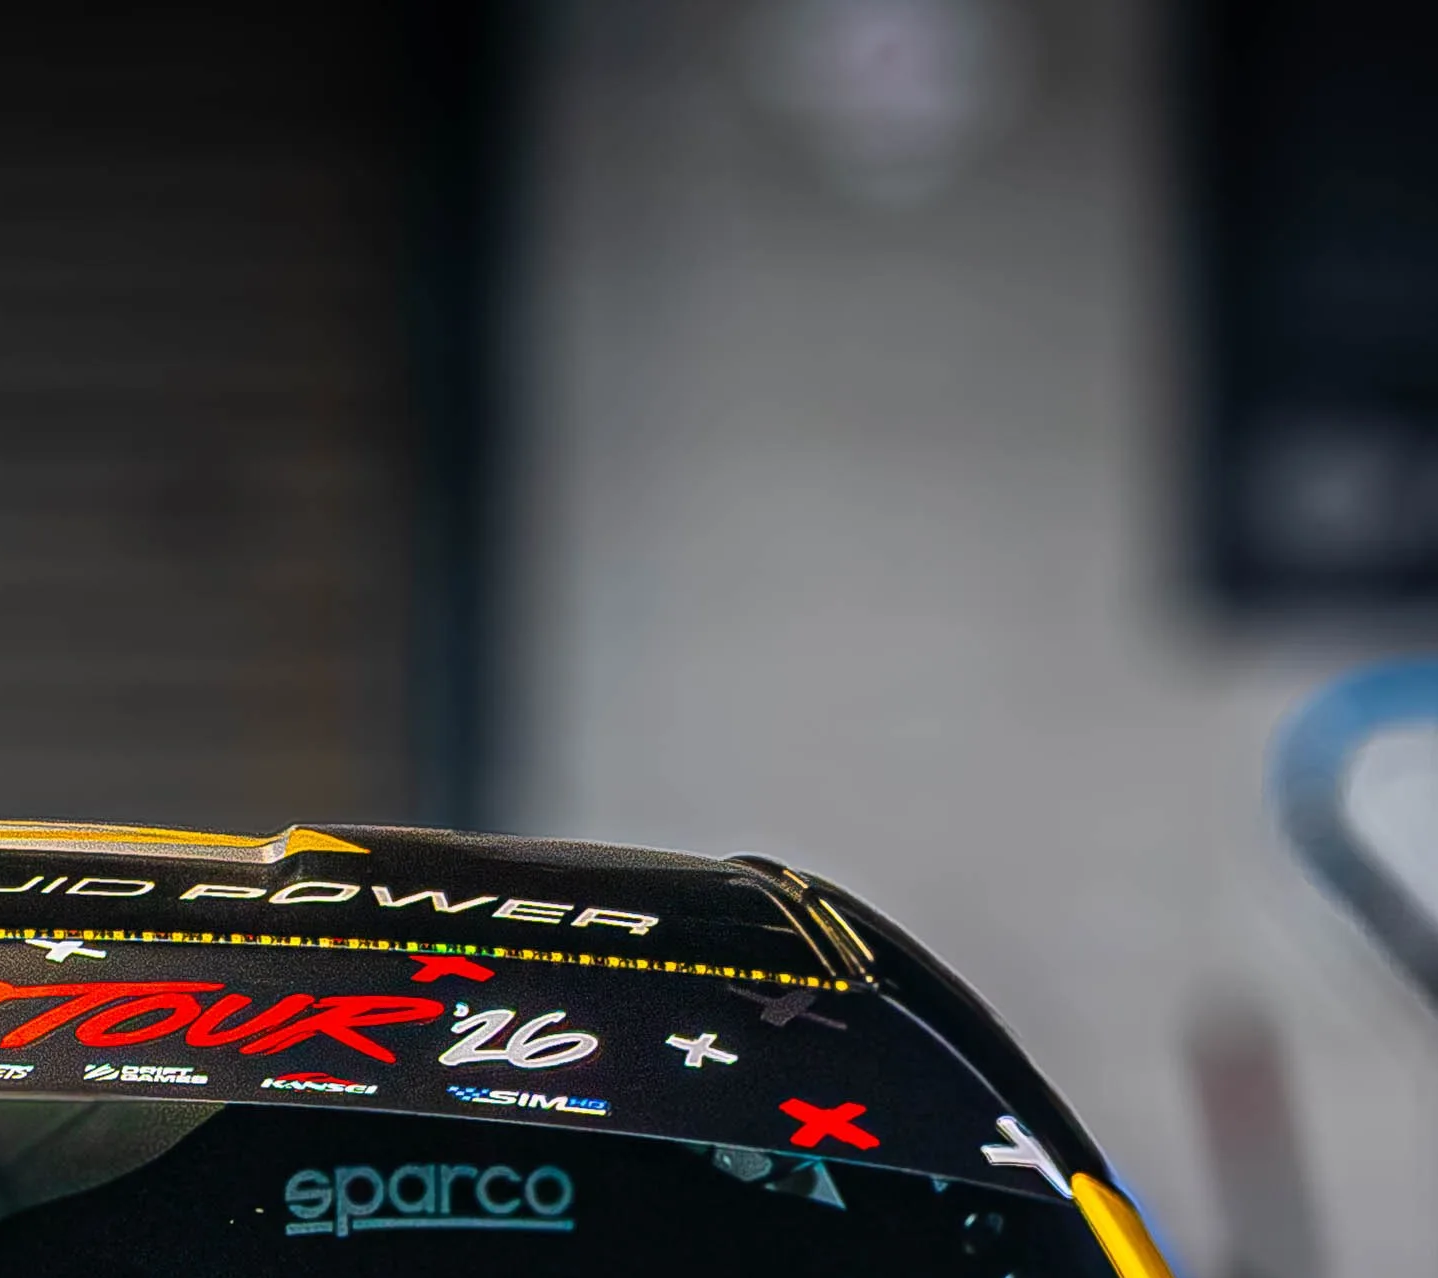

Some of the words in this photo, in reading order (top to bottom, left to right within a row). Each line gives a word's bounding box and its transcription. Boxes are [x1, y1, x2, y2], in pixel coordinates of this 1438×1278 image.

[179, 880, 660, 937] POWER
[260, 1077, 379, 1095] KANSEI
[285, 1164, 574, 1237] sparco
